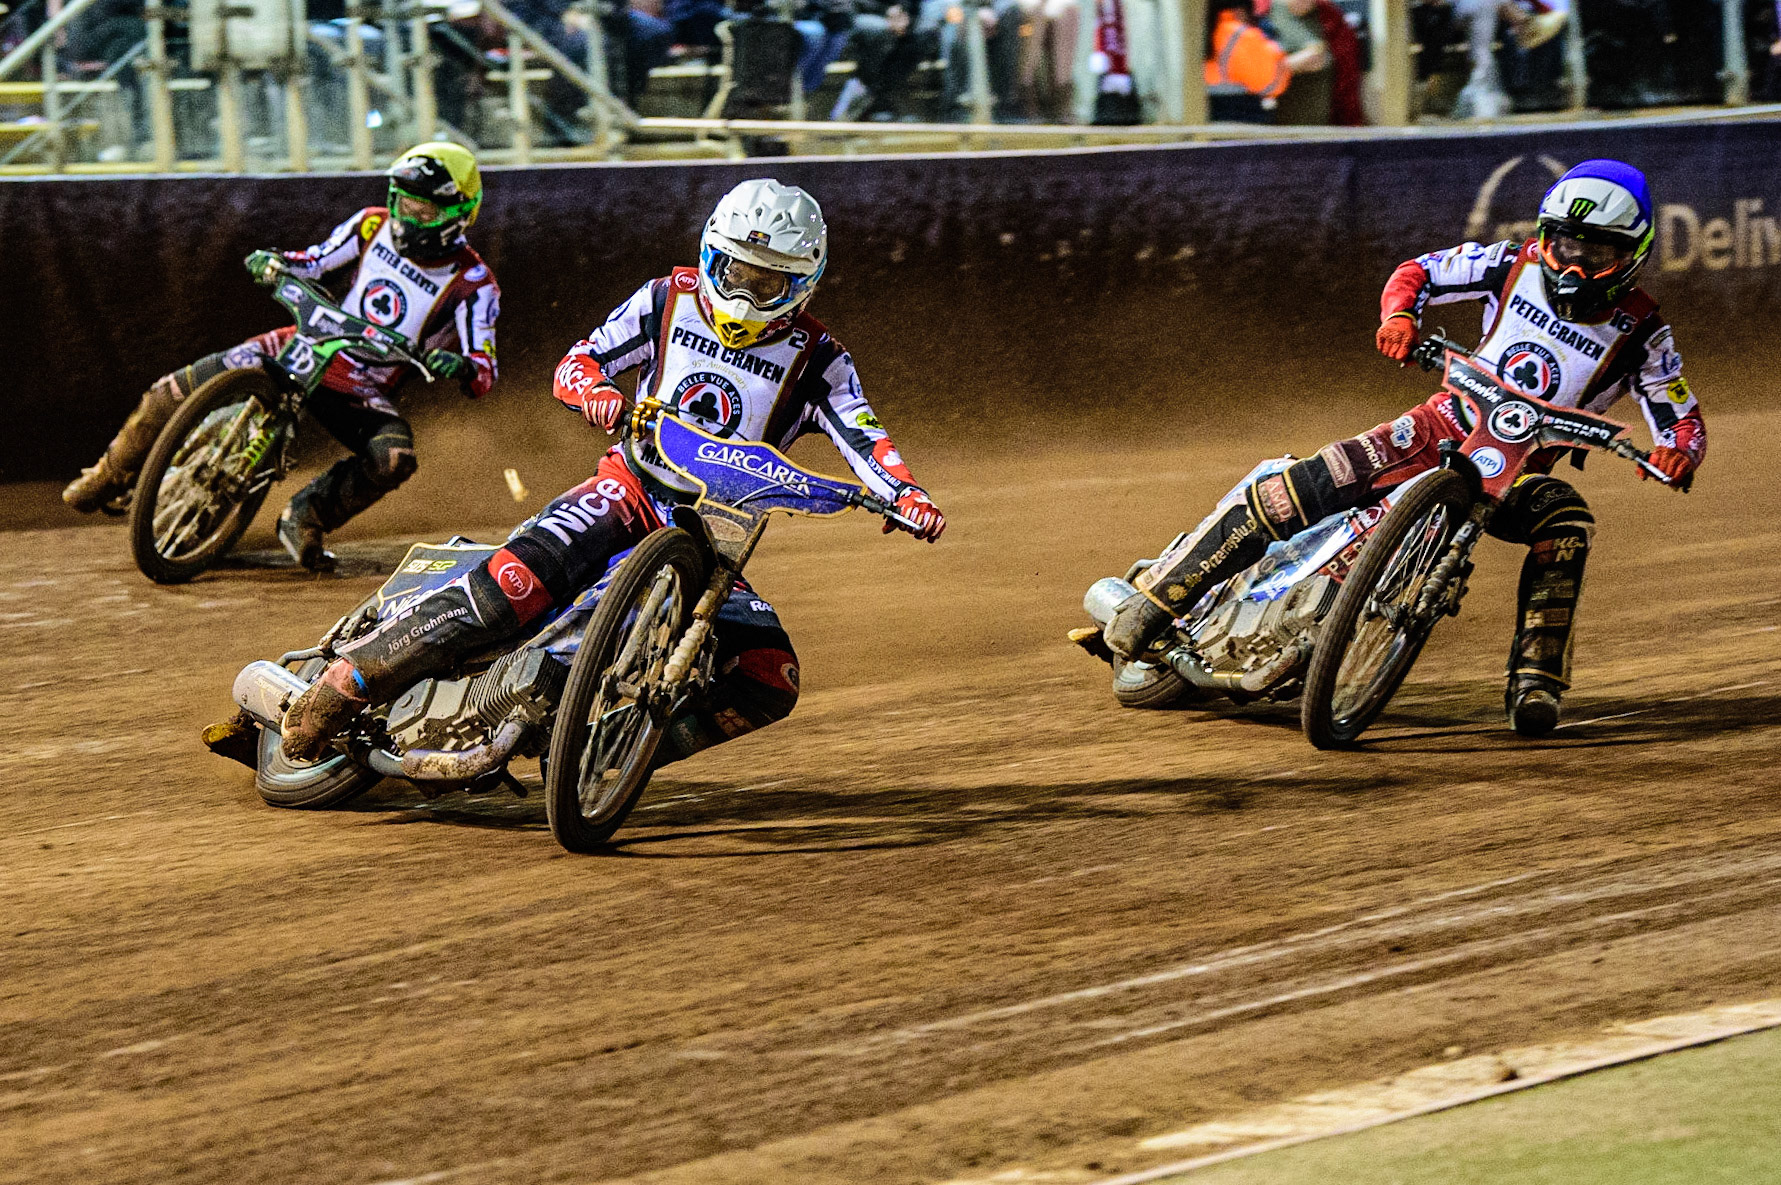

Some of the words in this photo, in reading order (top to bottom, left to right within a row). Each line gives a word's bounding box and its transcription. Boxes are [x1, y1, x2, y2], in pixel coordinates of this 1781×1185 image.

[371, 242, 401, 270] PETER
[401, 262, 440, 297] CRAVEN
[788, 327, 810, 351] 2
[1508, 294, 1548, 333] PETER
[1548, 317, 1606, 361] CRAVEN
[1608, 308, 1638, 335] 16
[671, 326, 720, 359] PETER
[720, 347, 786, 385] CRAVEN
[677, 374, 706, 393] BELLE
[710, 374, 730, 390] VUE
[728, 390, 741, 415] ACES
[697, 442, 811, 497] GARCAREK
[1475, 454, 1499, 470] ATPI
[537, 477, 627, 547] Nice
[504, 569, 526, 593] ATPI
[388, 635, 411, 654] Jörg
[410, 606, 469, 638] Grohmann
